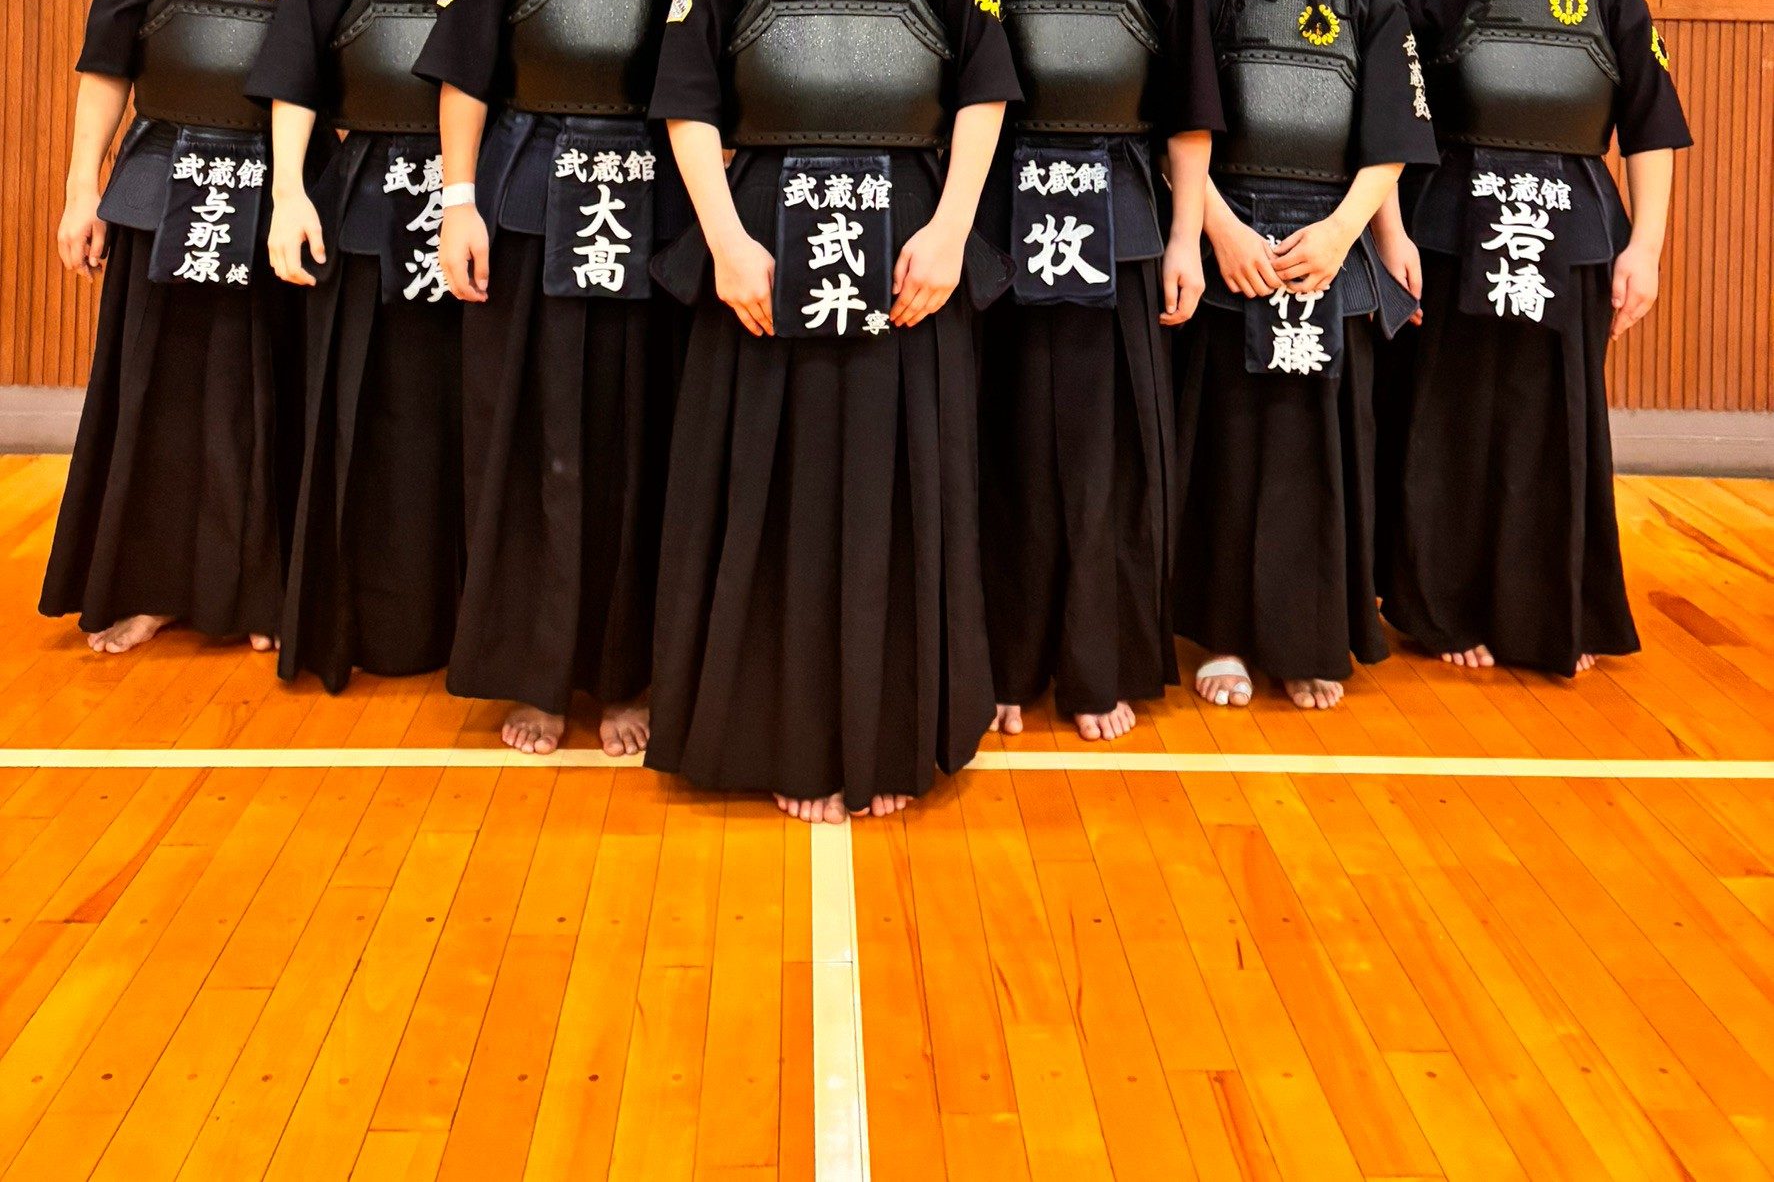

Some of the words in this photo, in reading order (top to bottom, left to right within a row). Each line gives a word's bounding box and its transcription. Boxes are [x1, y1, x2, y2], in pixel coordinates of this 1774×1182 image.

[172, 152, 267, 189] 武蔵館
[382, 154, 443, 196] 武蔵
[554, 148, 657, 184] 武蔵館
[1017, 159, 1109, 197] 武蔵館
[782, 172, 893, 211] 武蔵館
[1471, 171, 1572, 211] 武蔵館
[172, 186, 235, 283] 与那原
[1023, 213, 1110, 286] 牧
[800, 212, 868, 336] 武井
[1480, 201, 1556, 323] 岩橋
